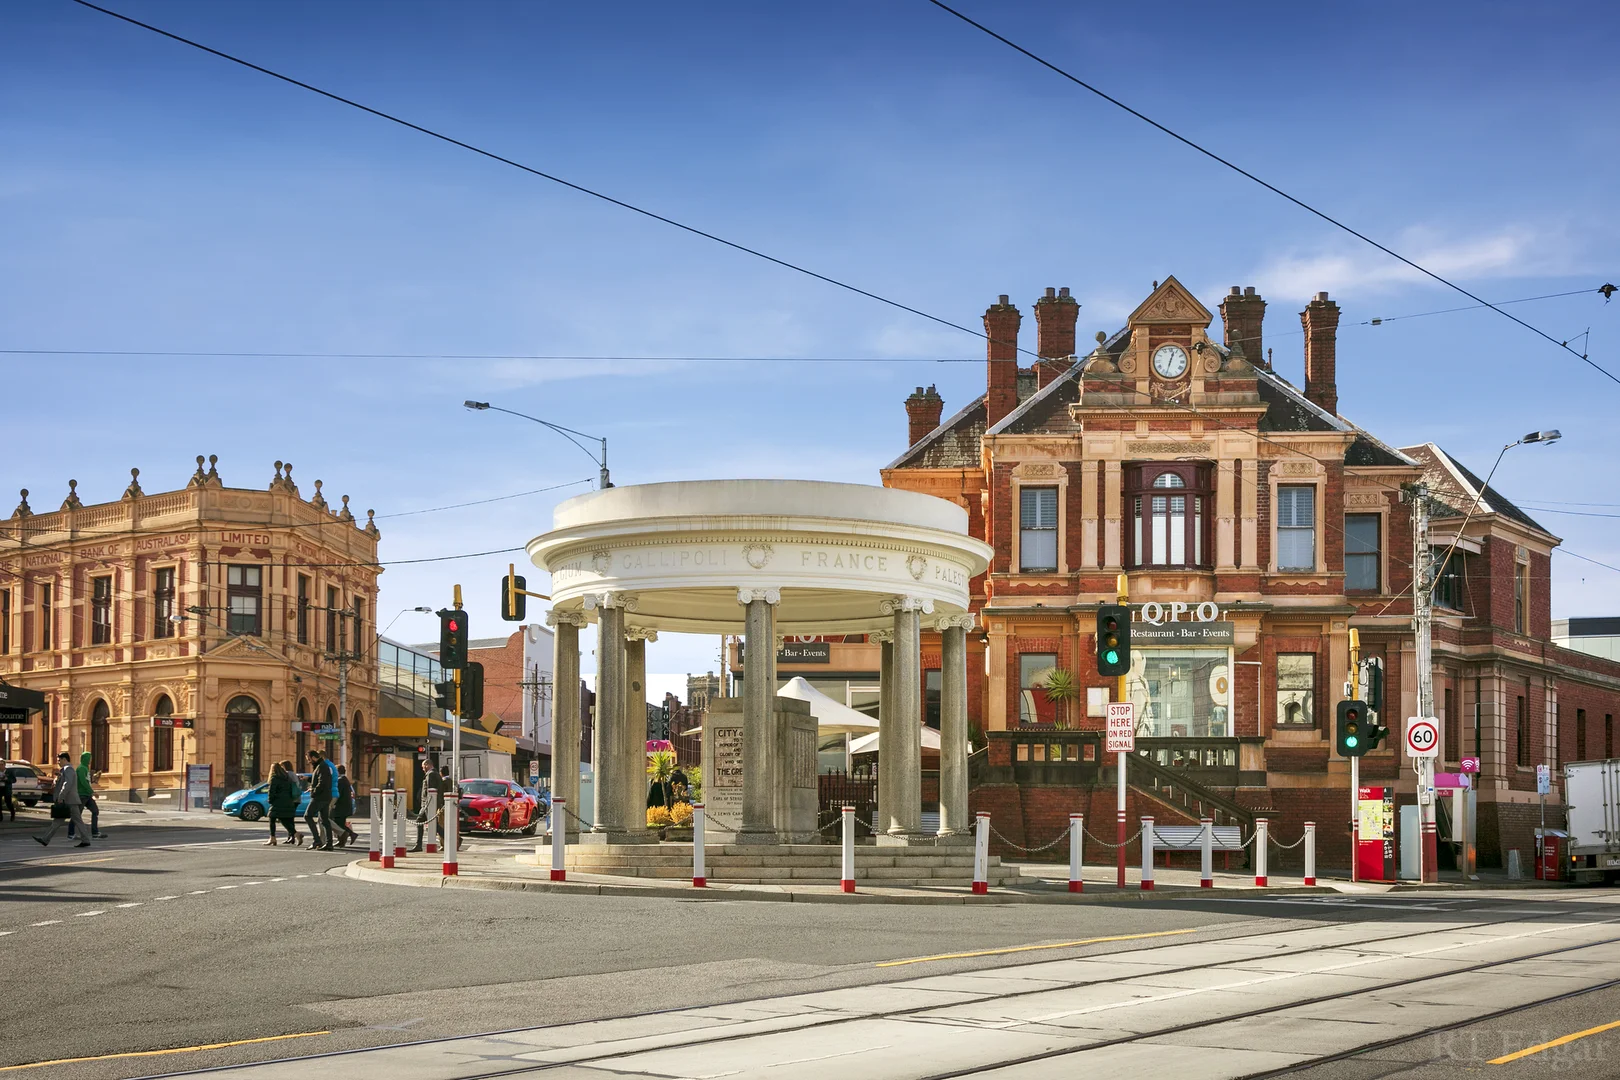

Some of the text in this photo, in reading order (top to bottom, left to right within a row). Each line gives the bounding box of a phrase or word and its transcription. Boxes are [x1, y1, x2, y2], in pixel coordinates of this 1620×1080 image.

[25, 552, 63, 567] NATIONAL
[80, 547, 105, 559] BANK
[108, 543, 120, 555] OF
[136, 533, 191, 551] AUSTRALASIA
[221, 532, 270, 545] LIMITED
[800, 551, 888, 572] FRANCE
[1141, 601, 1219, 626] QPO
[1130, 628, 1230, 638] Restaurant Bar Events
[784, 649, 798, 657] Bar
[803, 649, 826, 657] Events
[1110, 706, 1131, 716] STOP
[321, 722, 333, 730] nab
[1110, 718, 1131, 728] HERE
[717, 729, 738, 737] CITY
[1108, 730, 1132, 738] ON RED
[1413, 730, 1433, 743] 60
[1108, 740, 1132, 748] SIGNAL
